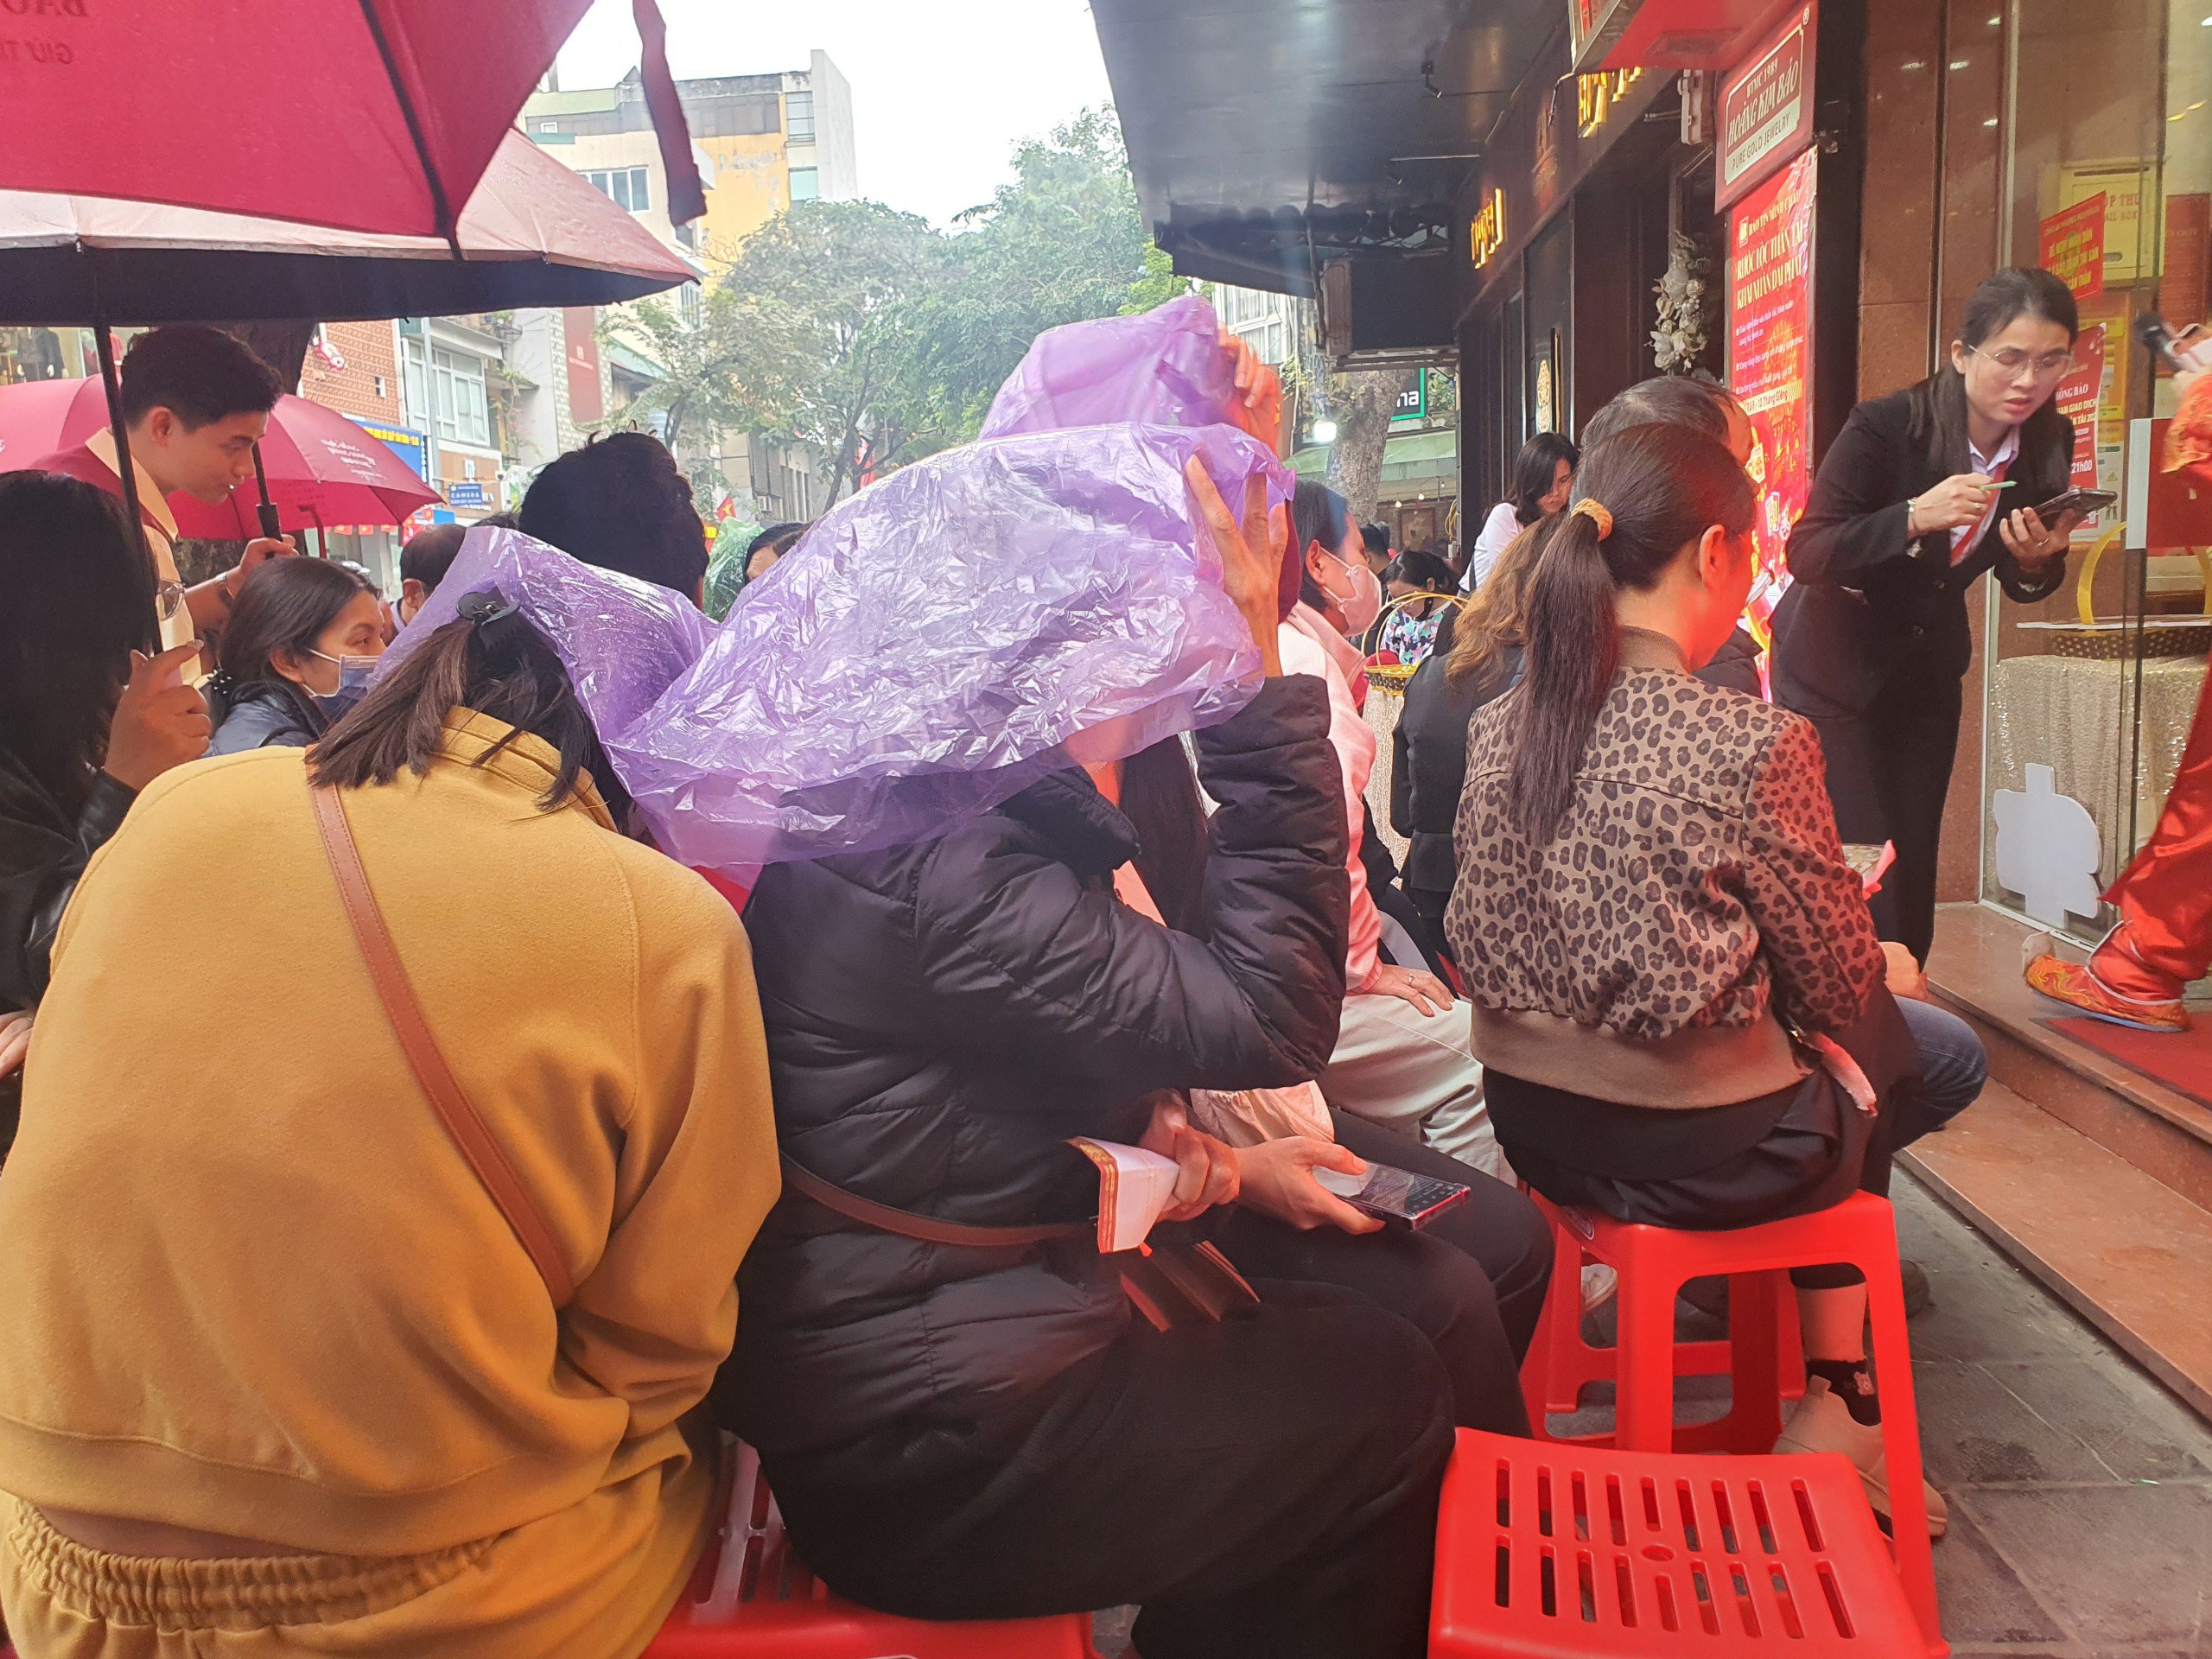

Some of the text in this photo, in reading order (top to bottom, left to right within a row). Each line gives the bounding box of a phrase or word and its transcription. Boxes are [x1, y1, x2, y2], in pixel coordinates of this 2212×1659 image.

[1764, 57, 1778, 81] 1989
[1757, 81, 1777, 123] KIM
[1732, 112, 1792, 171] PURE GOLD JEWELRY
[2074, 381, 2088, 397] BÁO
[2070, 459, 2093, 474] 21h00
